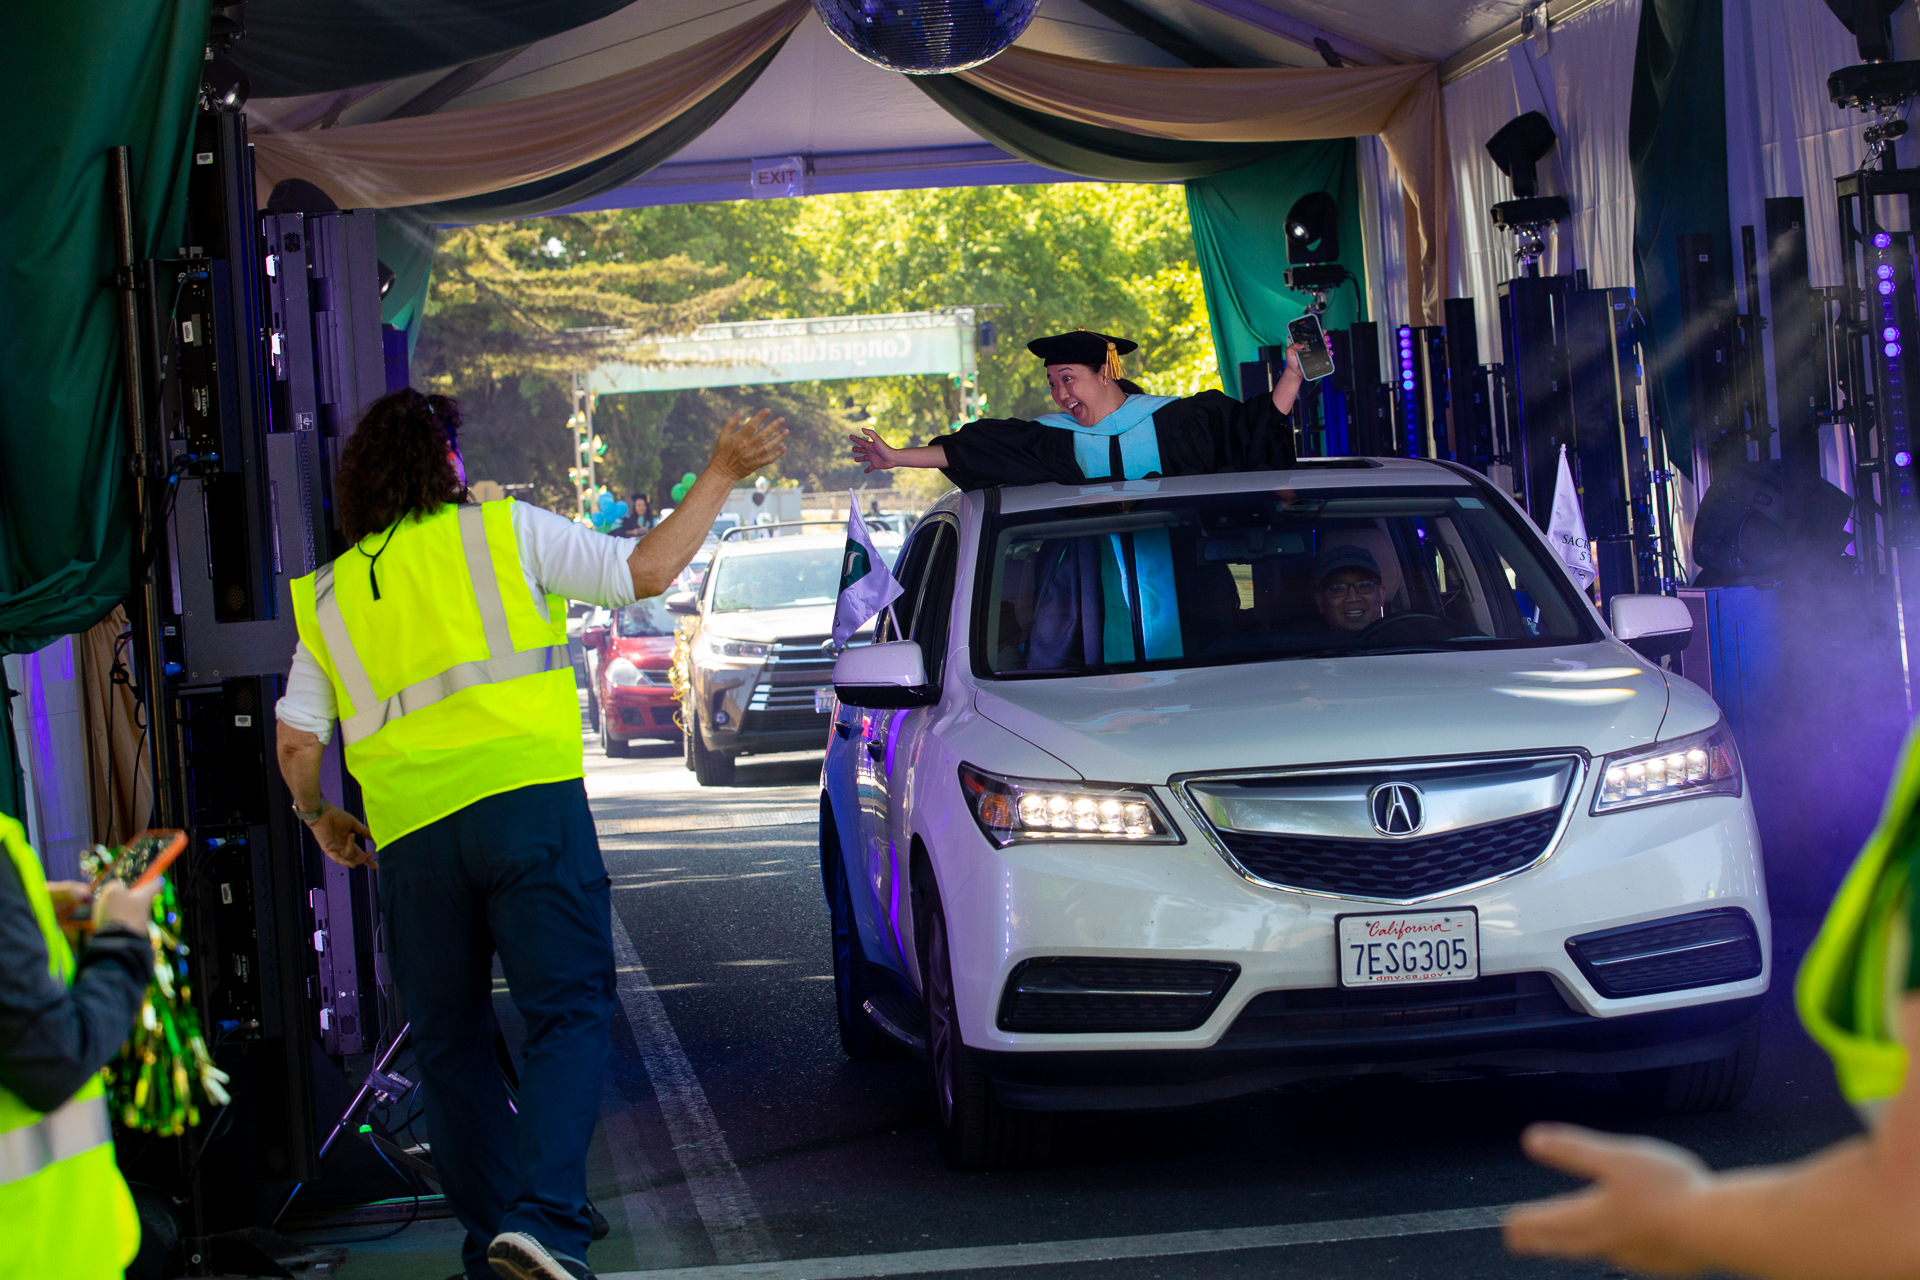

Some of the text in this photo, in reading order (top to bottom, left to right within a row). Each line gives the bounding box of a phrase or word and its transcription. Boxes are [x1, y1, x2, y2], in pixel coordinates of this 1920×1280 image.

[758, 170, 796, 185] EXIT
[1369, 919, 1451, 940] California
[1350, 938, 1467, 975] 7ESG305
[1376, 972, 1444, 982] dmv.ca.gov
